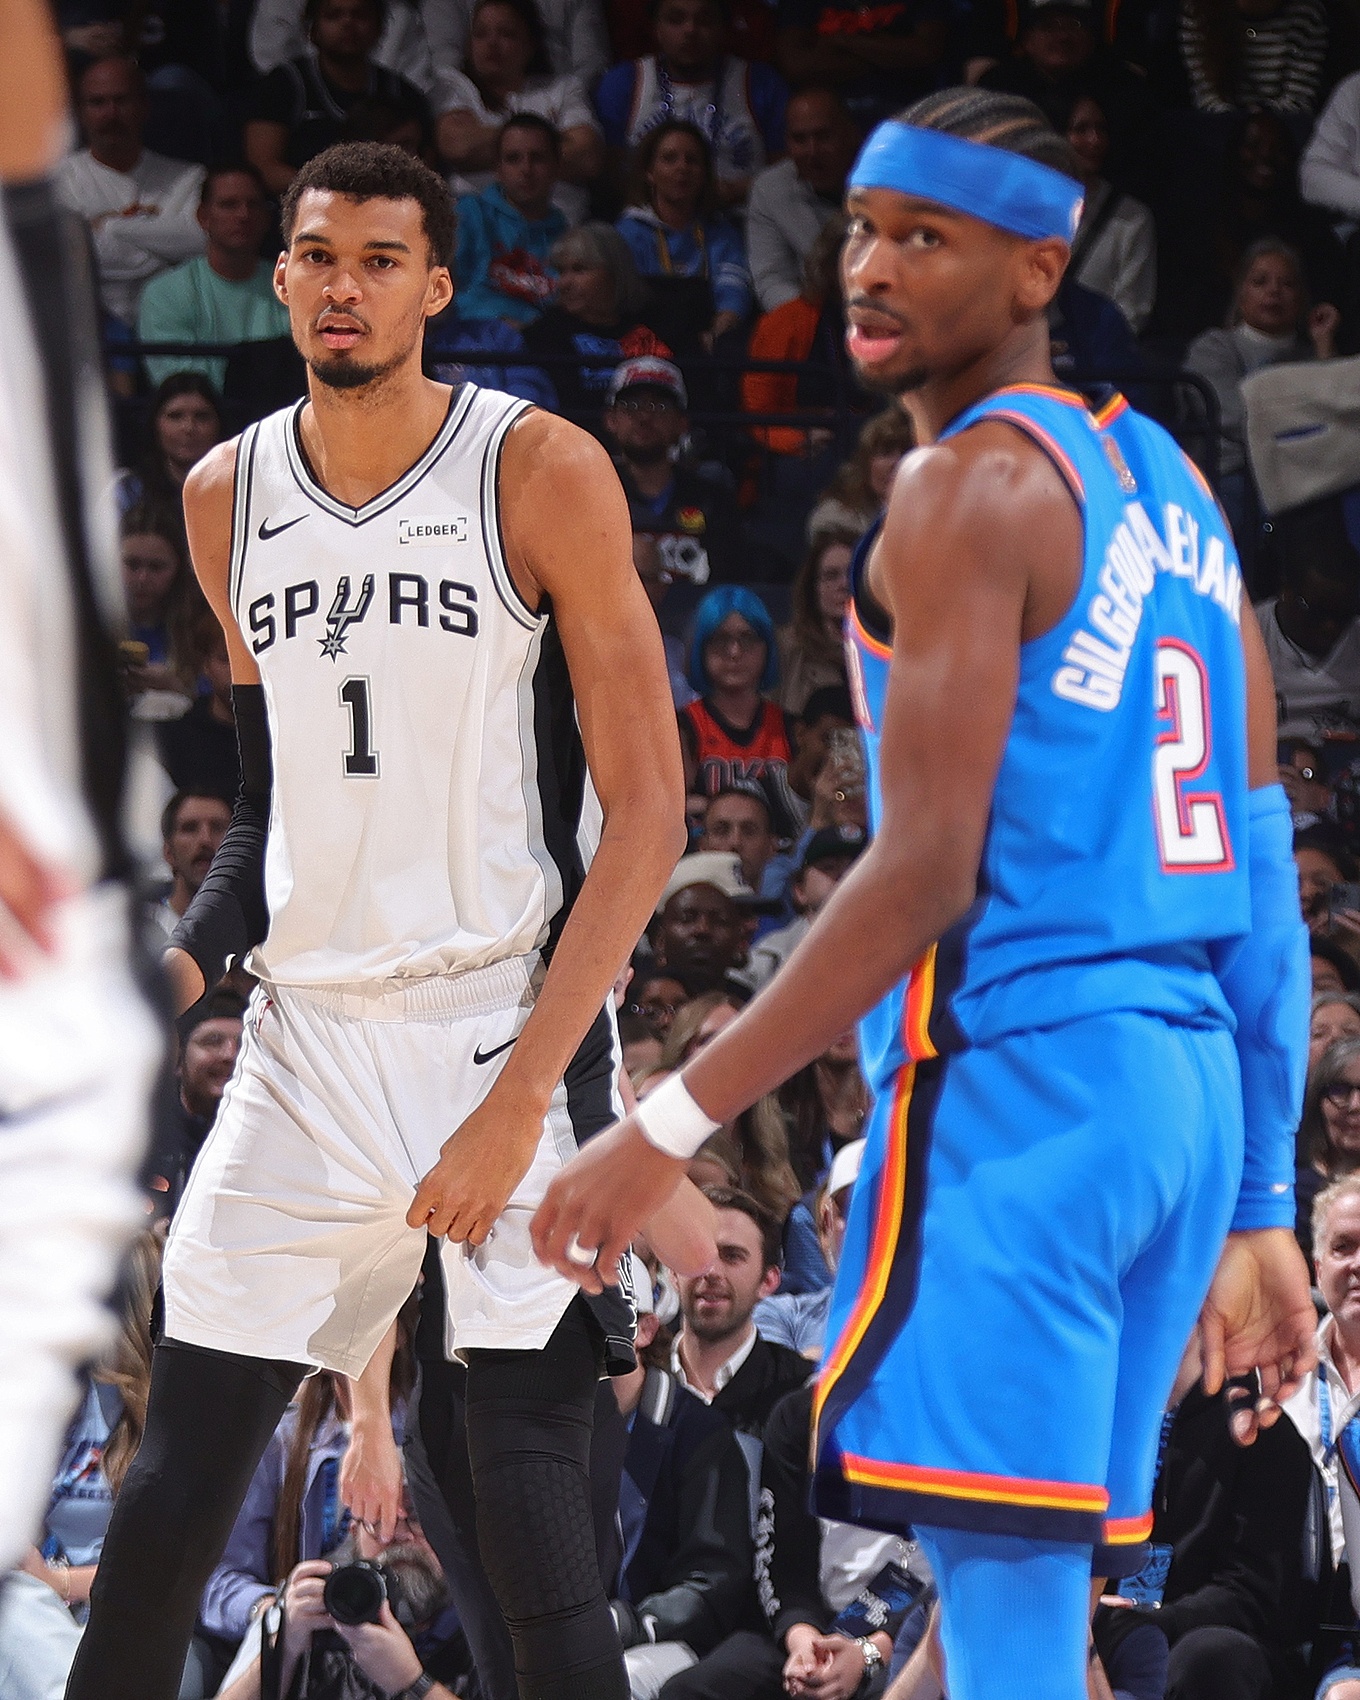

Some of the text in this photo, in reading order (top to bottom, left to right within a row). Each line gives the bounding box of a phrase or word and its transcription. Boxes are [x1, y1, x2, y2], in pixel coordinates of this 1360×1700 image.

[408, 524, 458, 537] LEDGER
[249, 571, 479, 664] SPURS
[338, 674, 381, 779] 1
[1154, 635, 1236, 875] 2
